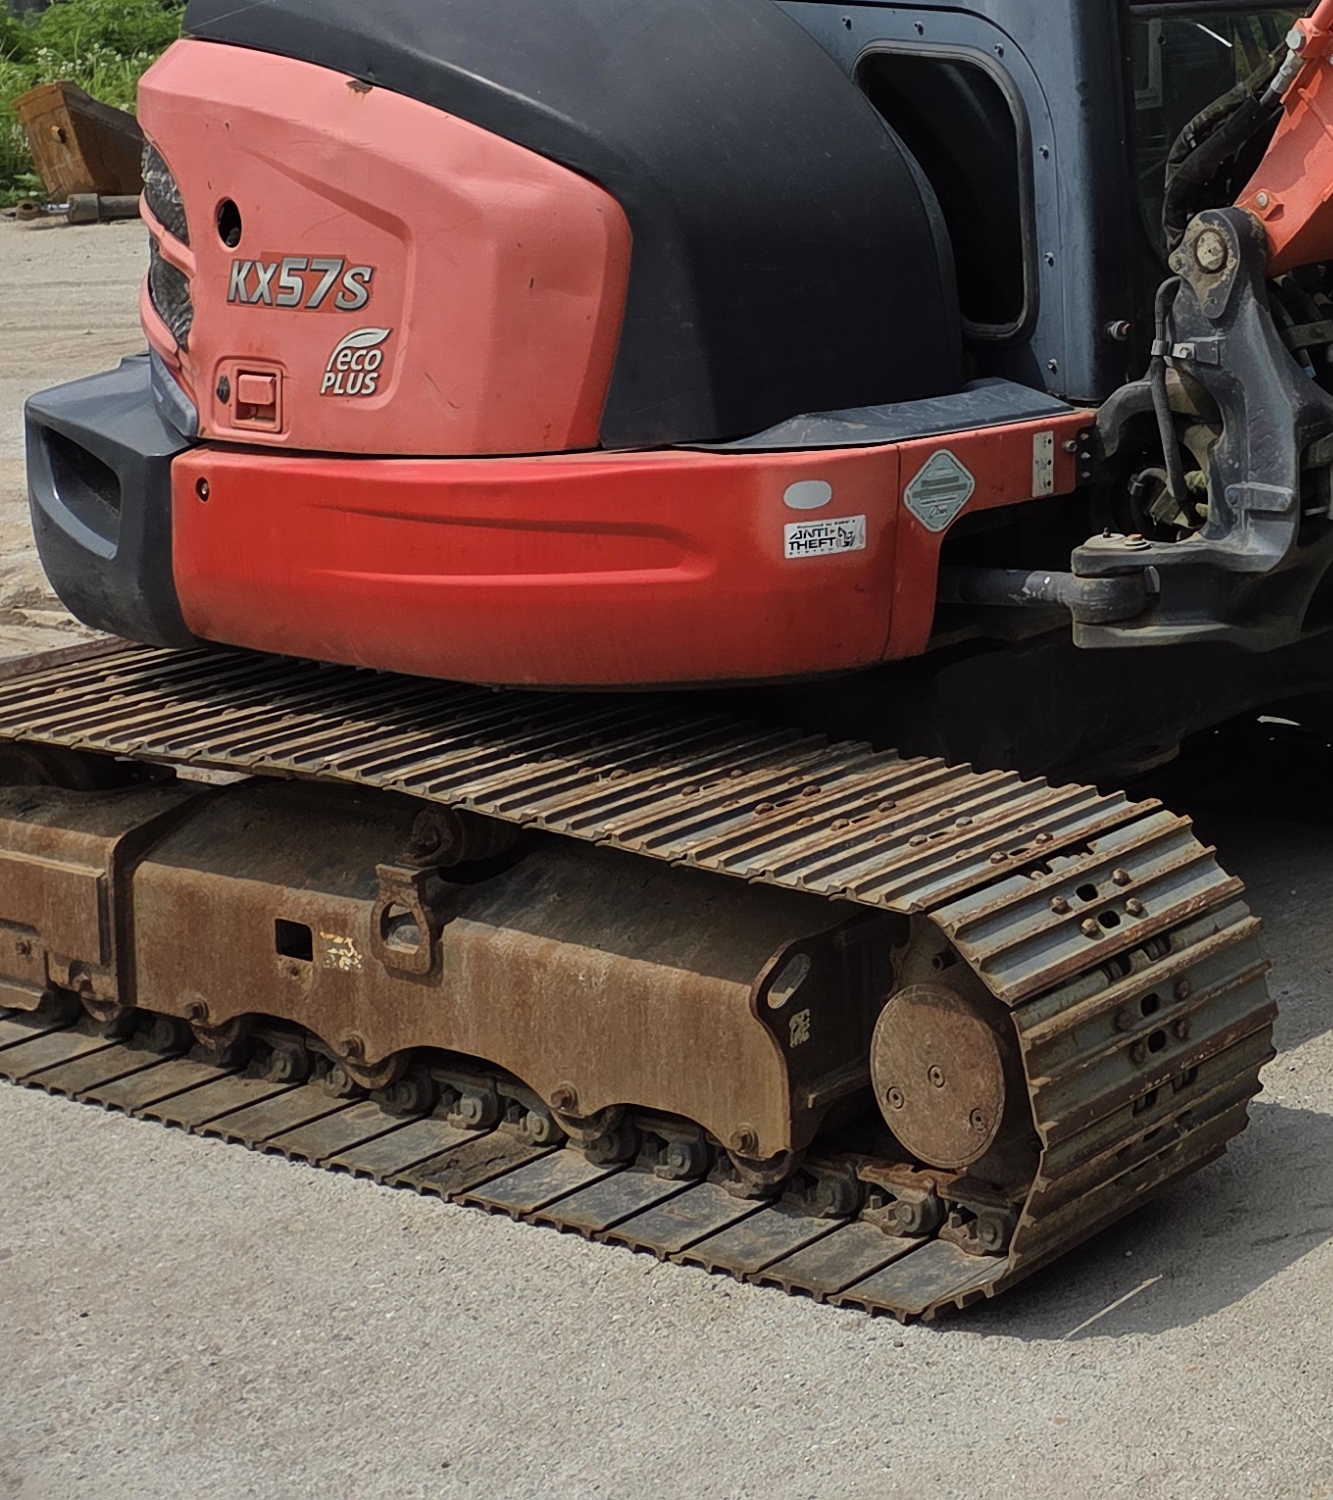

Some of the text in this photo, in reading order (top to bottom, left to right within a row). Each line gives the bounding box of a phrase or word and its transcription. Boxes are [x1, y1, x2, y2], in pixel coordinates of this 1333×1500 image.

[227, 257, 374, 312] KX57S
[336, 348, 383, 371] eco
[320, 372, 379, 395] PLUS
[788, 537, 837, 551] THEFT
